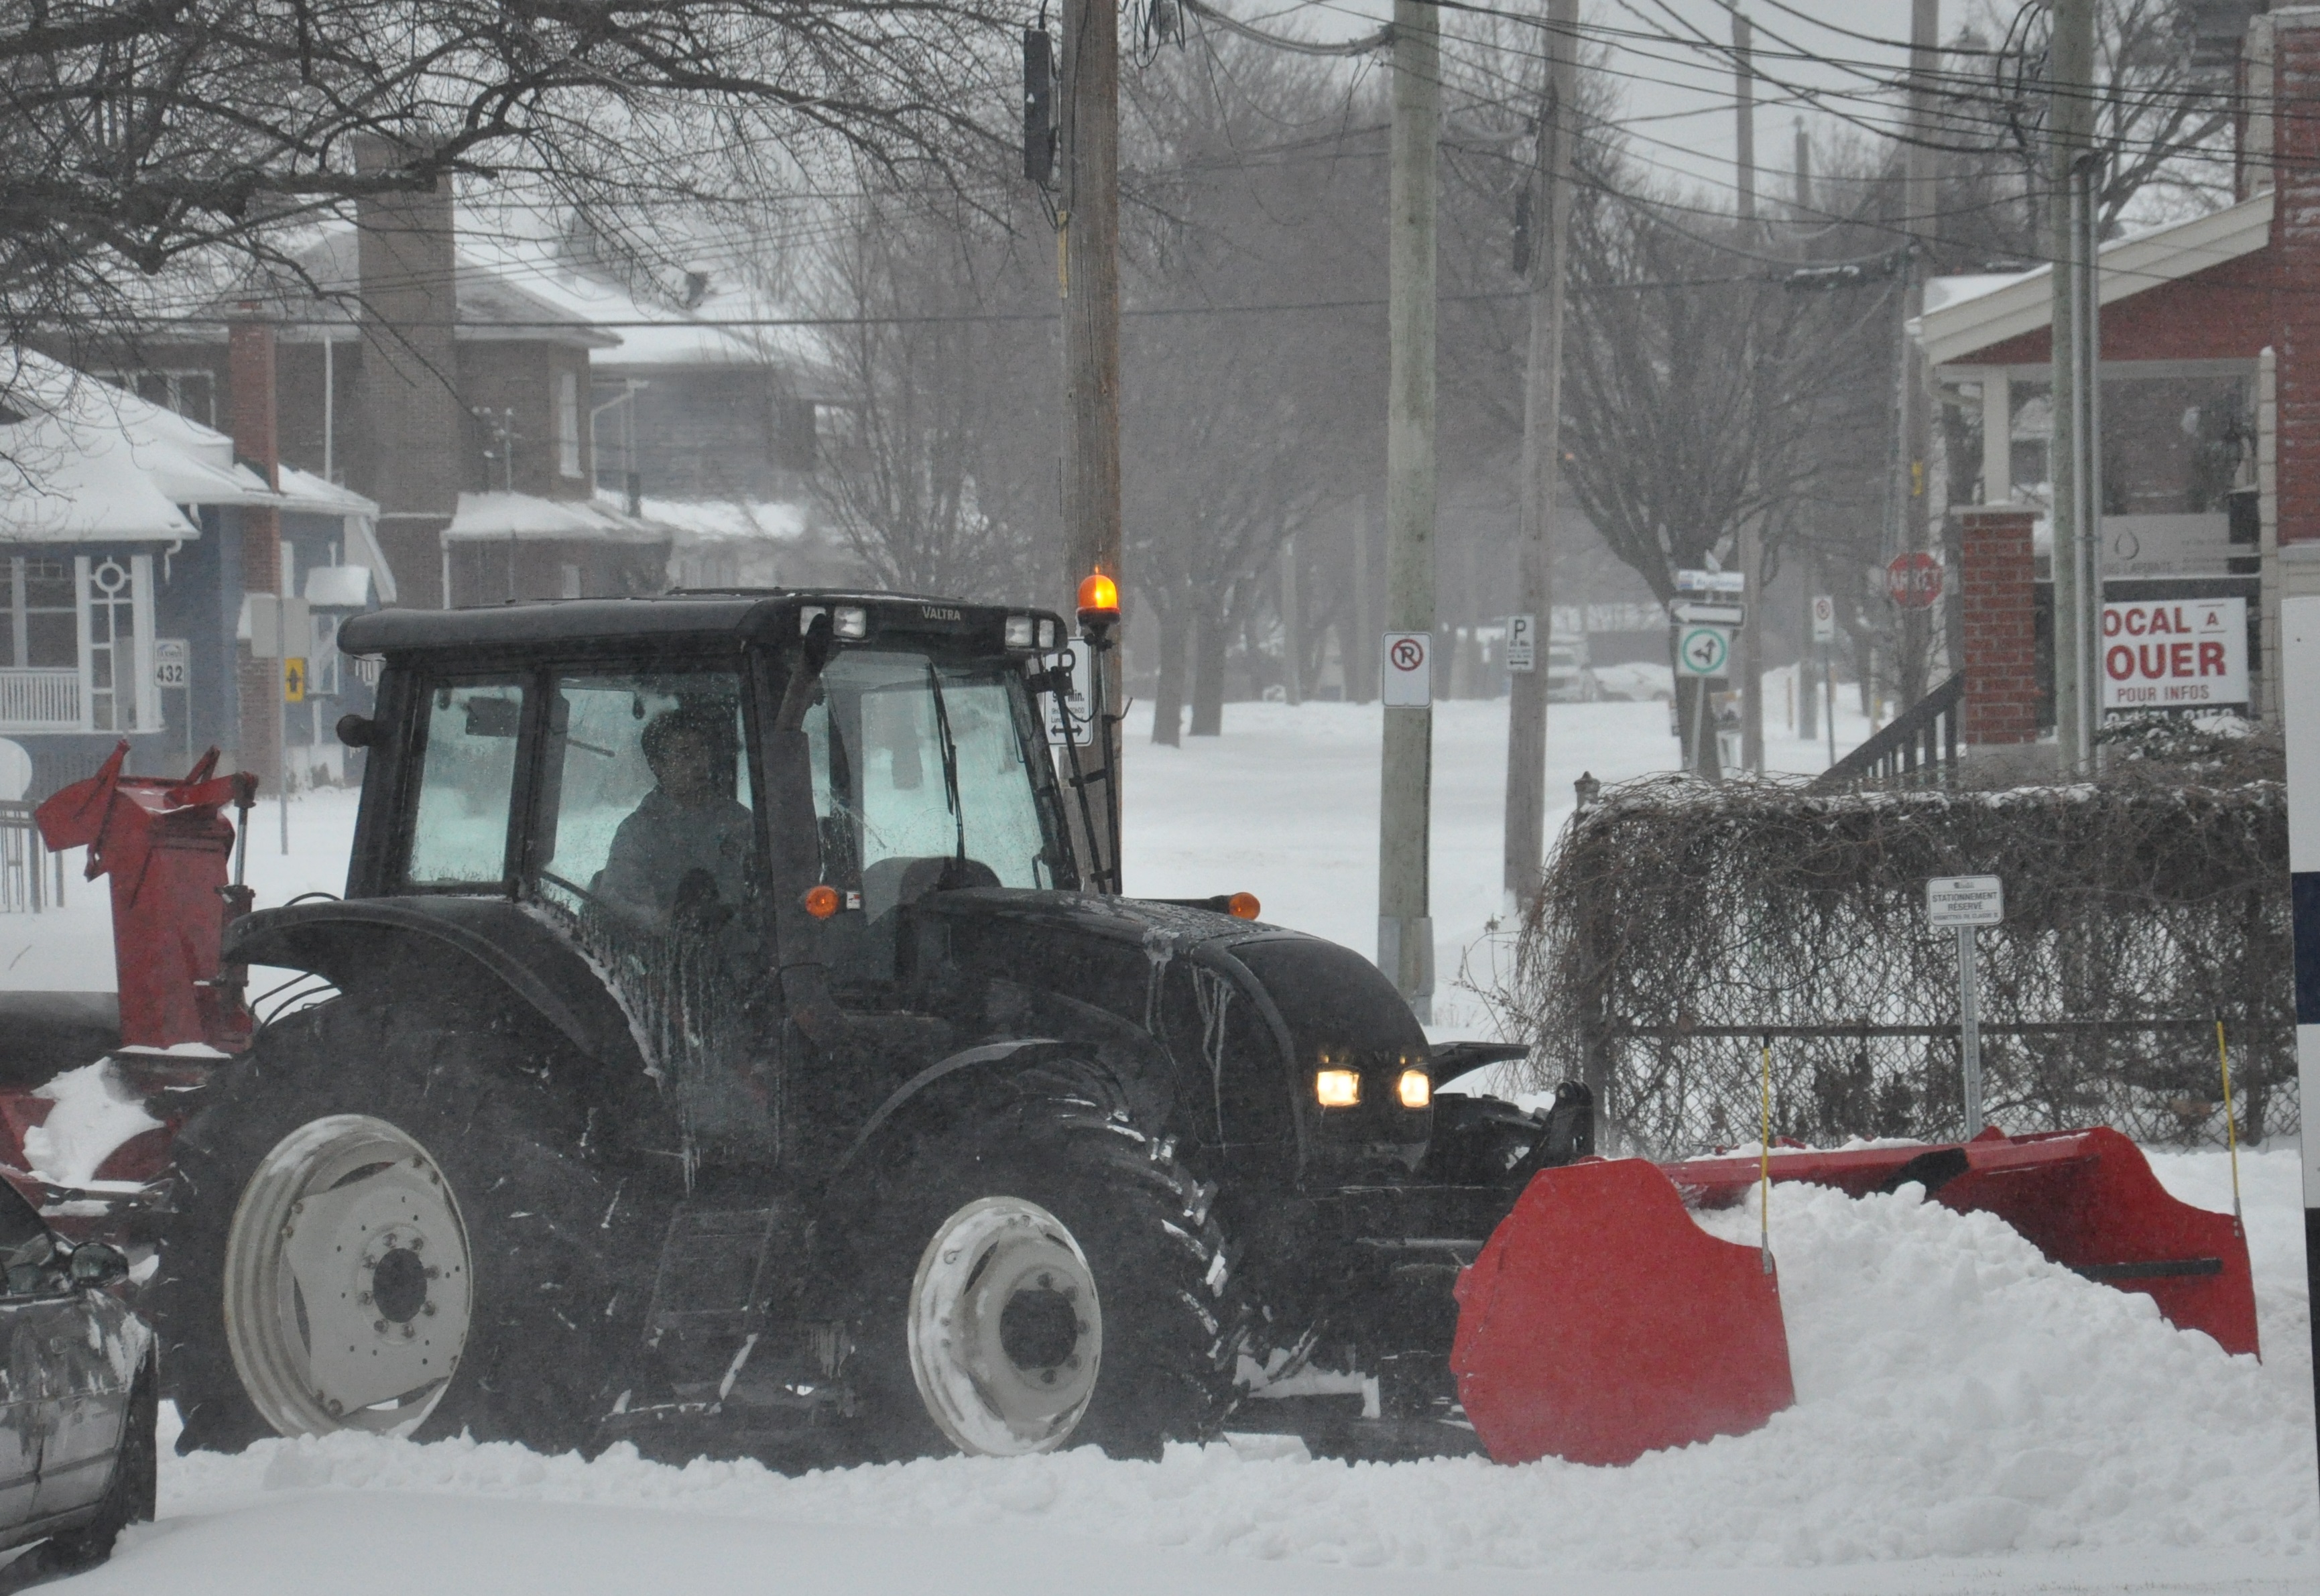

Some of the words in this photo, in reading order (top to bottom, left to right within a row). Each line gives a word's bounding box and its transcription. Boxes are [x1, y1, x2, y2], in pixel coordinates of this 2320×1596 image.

[922, 605, 961, 621] VALTRA
[2103, 607, 2192, 637] OCAL
[1514, 619, 1526, 640] P
[2106, 641, 2227, 681] OUER
[157, 665, 183, 682] 432
[2117, 686, 2156, 702] POUR
[2164, 684, 2210, 700] INFOS
[1932, 892, 1998, 902] STATIONNEMENT
